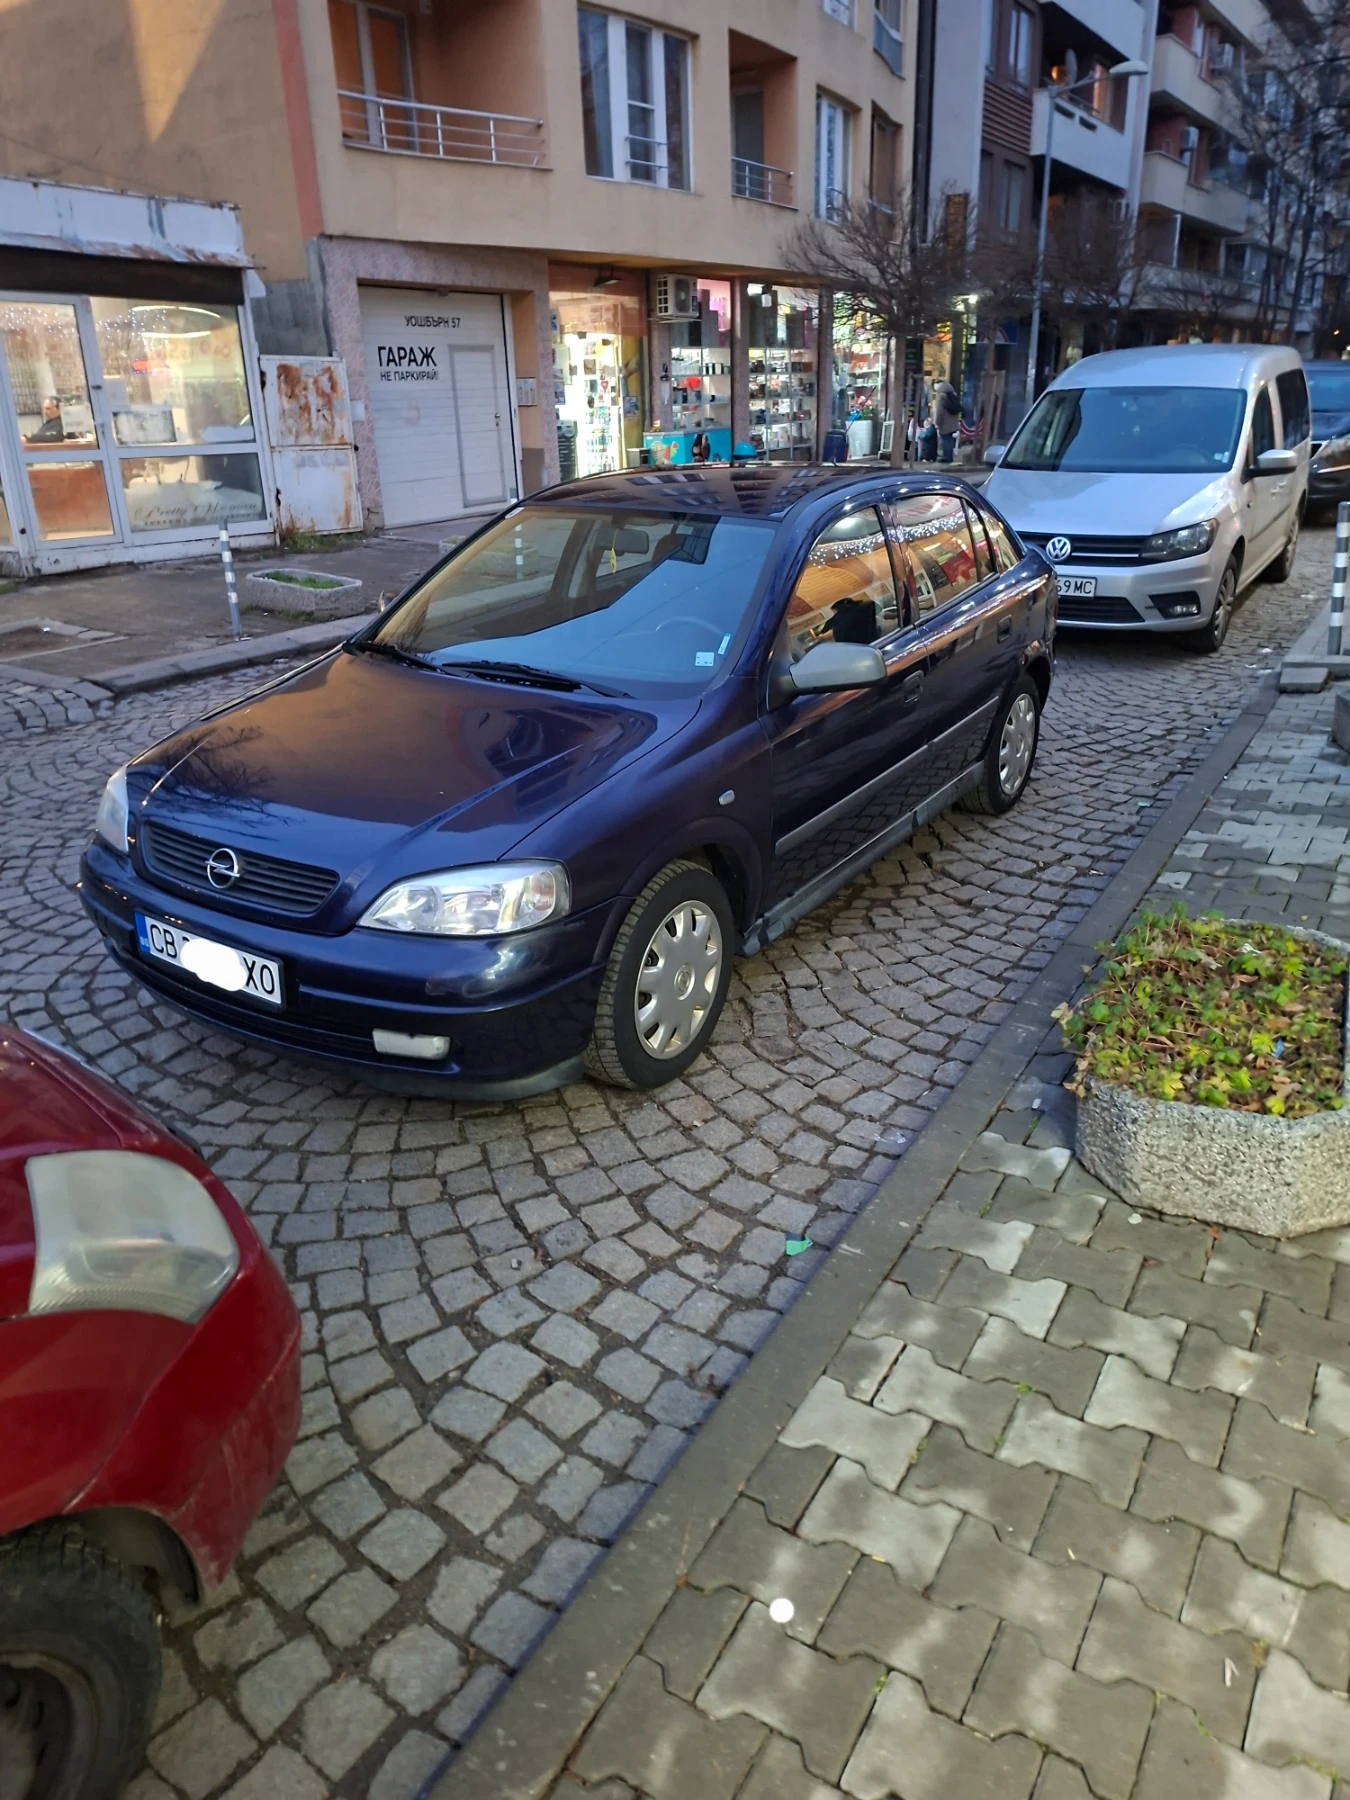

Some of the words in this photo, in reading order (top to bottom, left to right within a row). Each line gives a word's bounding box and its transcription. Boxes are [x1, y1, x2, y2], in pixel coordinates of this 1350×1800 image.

[404, 315, 450, 328] УОШБЪРН
[451, 317, 461, 328] 57
[377, 346, 437, 367] ГАРАЖ
[380, 371, 392, 381] НЕ
[1073, 580, 1093, 595] MC
[150, 924, 178, 959] CB
[242, 956, 275, 995] XO
